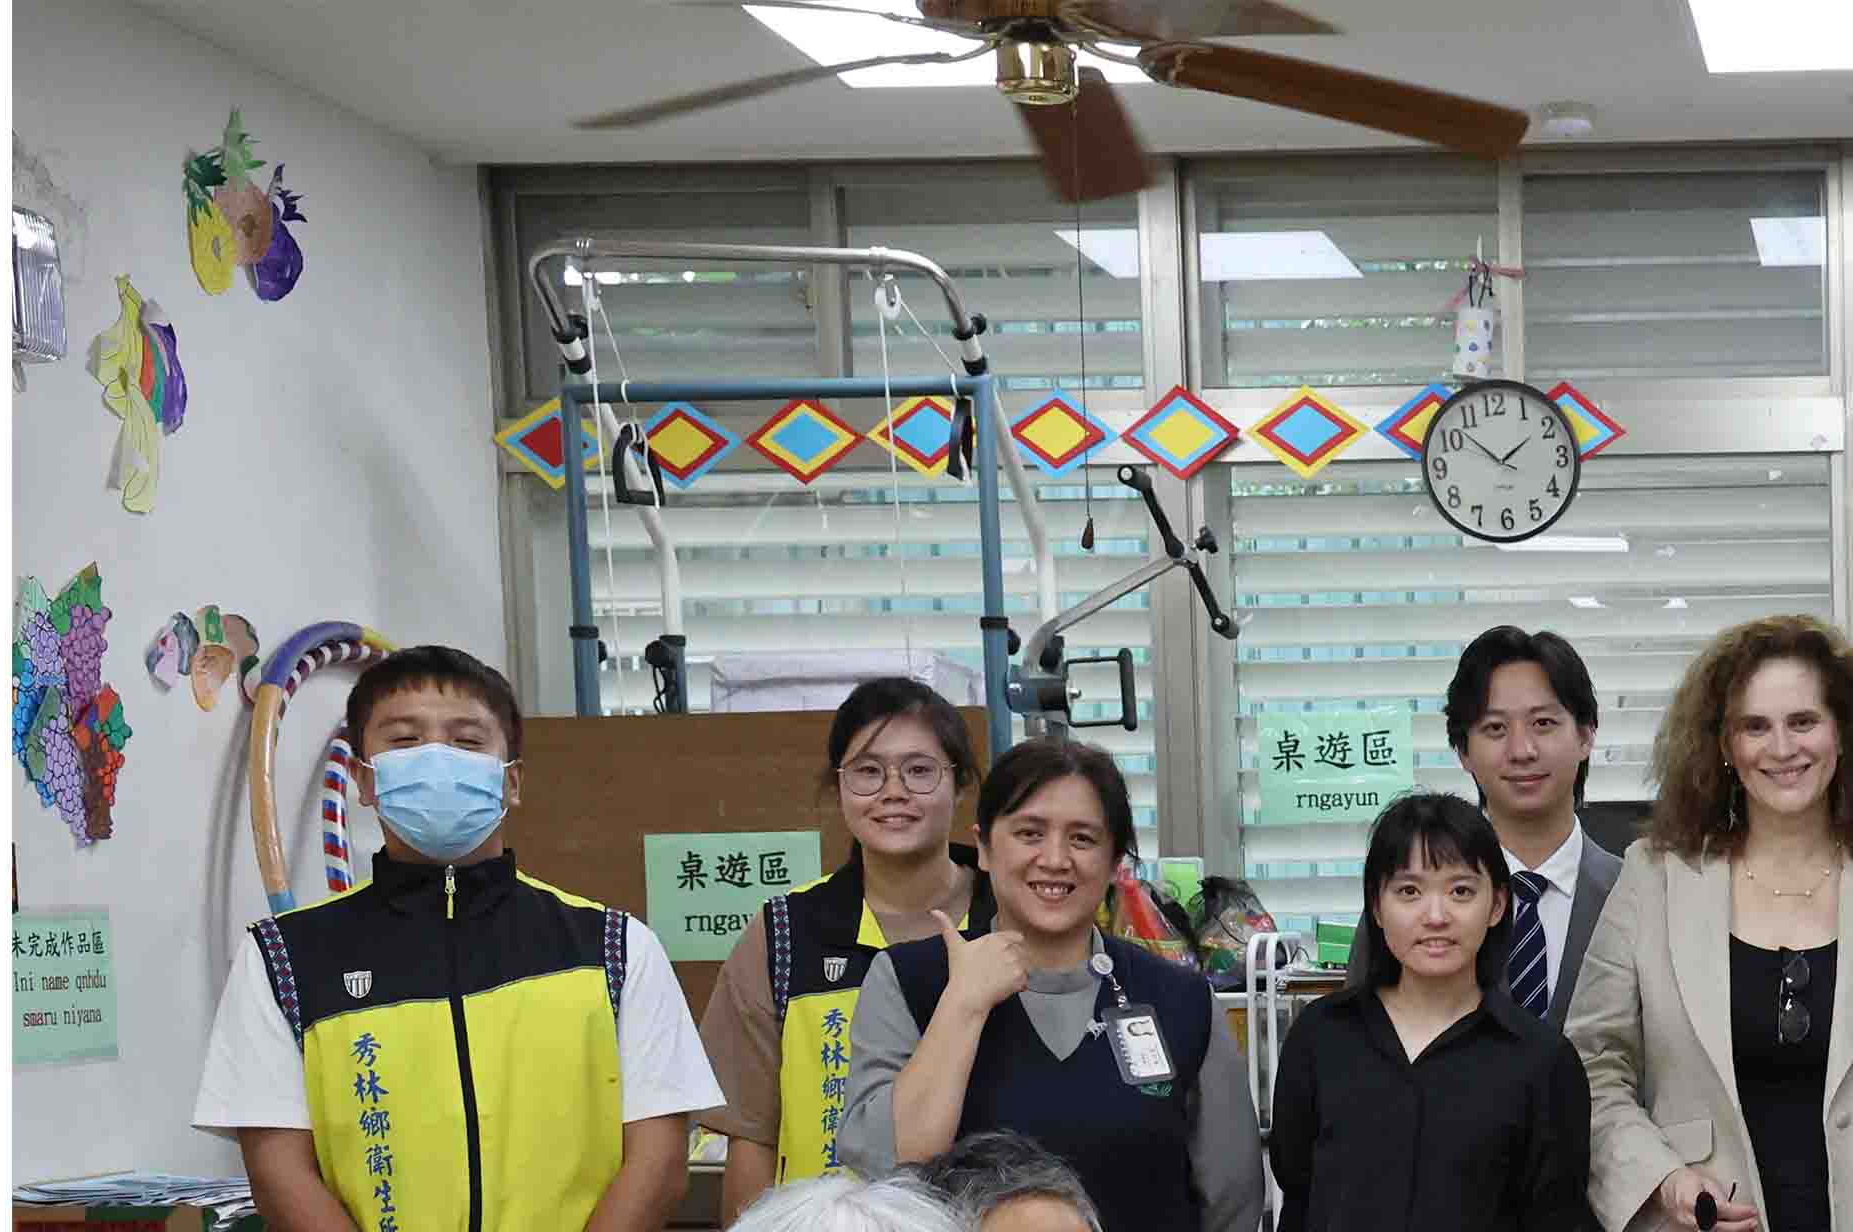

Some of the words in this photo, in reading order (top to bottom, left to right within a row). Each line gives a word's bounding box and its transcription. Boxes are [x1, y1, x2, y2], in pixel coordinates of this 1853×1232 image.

[1460, 404, 1478, 429] 11
[1483, 394, 1506, 417] 12
[1519, 397, 1529, 421] 1
[1541, 416, 1556, 440] 2
[1441, 428, 1464, 453] 10
[1432, 457, 1448, 480] 9
[1556, 445, 1569, 468] 3
[1447, 485, 1461, 508] 8
[1545, 474, 1560, 498] 4
[1470, 504, 1484, 528] 7
[1500, 507, 1515, 531] 6
[1528, 498, 1543, 522] 5
[1272, 729, 1398, 773] 桌遊區
[1296, 790, 1379, 811] rngayun
[676, 850, 791, 891] 桌遊區
[821, 1008, 853, 1177] 秀林鄉衛生
